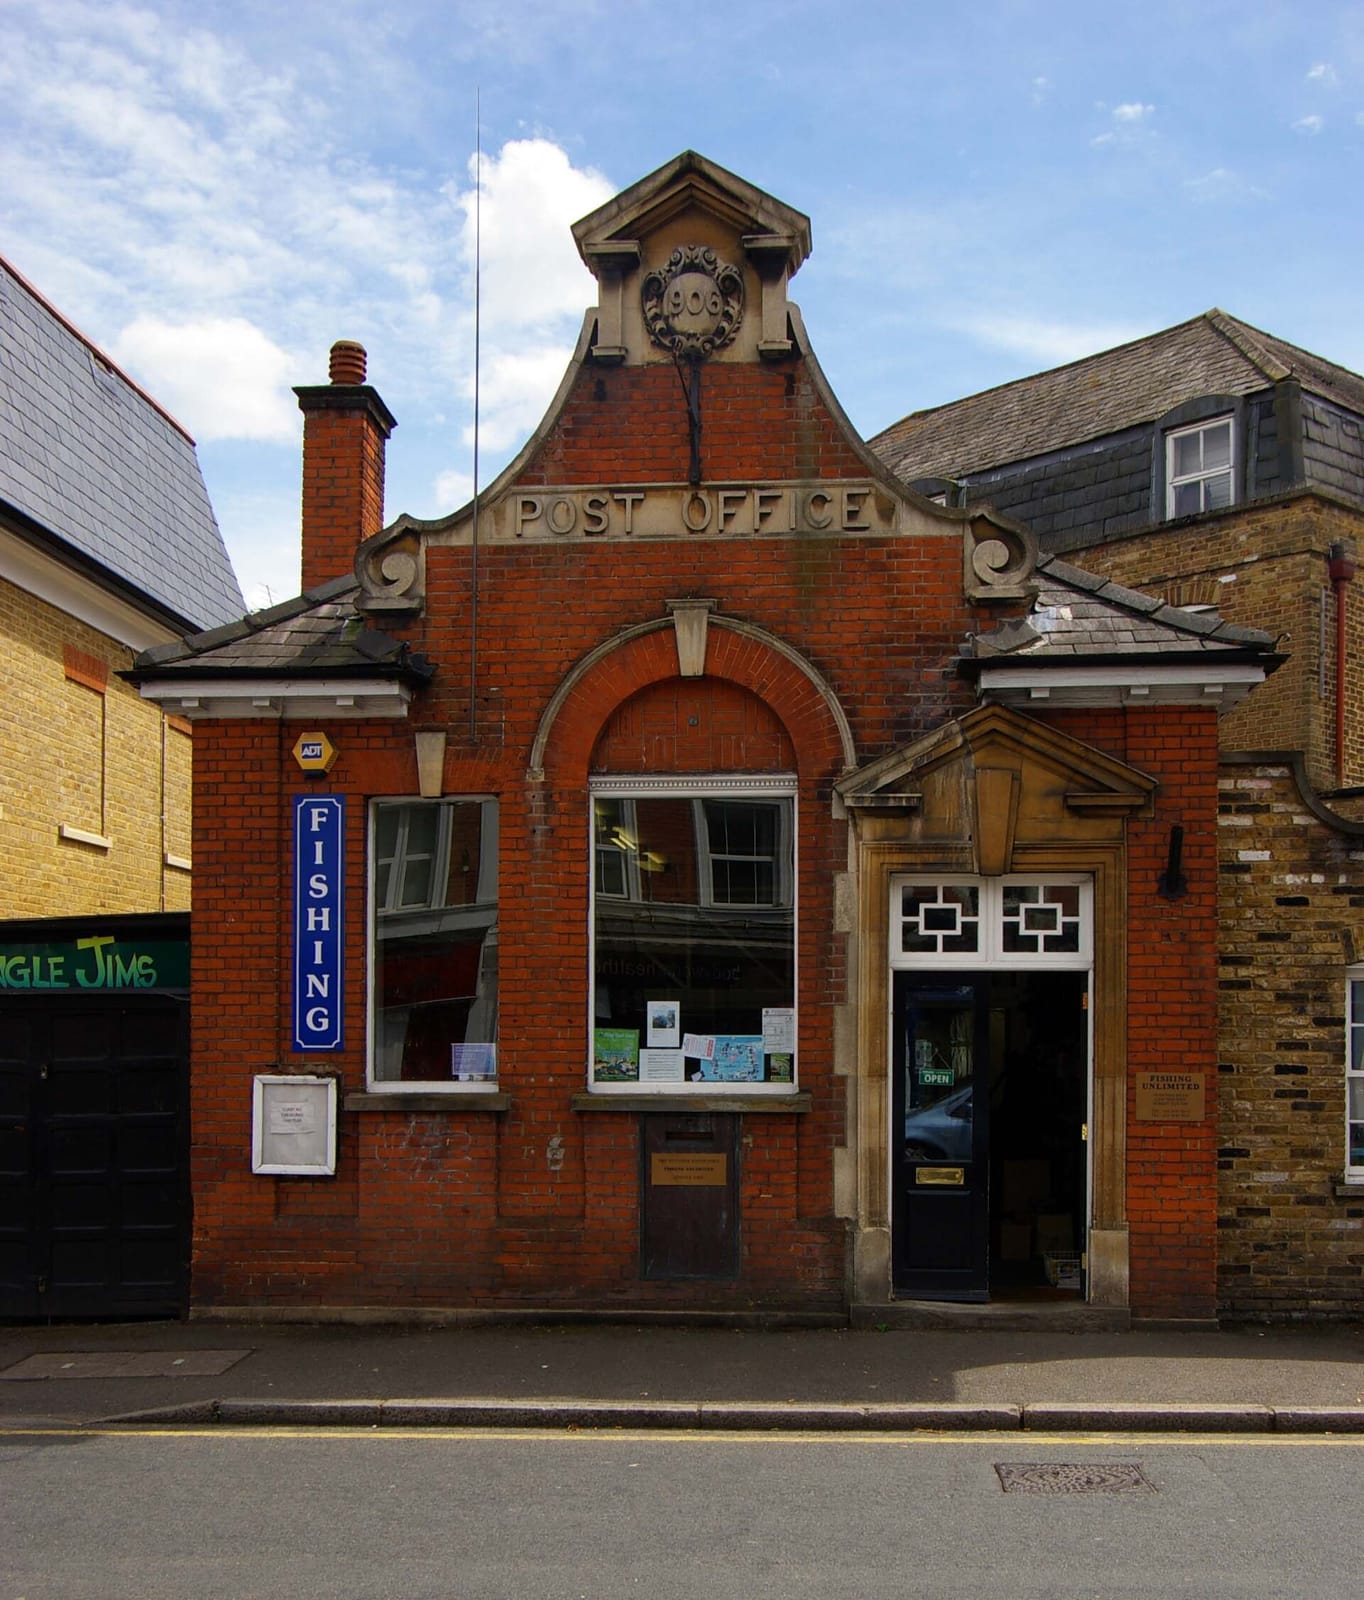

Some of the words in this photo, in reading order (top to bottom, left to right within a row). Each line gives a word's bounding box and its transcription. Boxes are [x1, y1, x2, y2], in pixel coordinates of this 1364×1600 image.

[515, 492, 645, 537] POST
[682, 487, 872, 533] OFFICE
[301, 745, 323, 757] ADT
[306, 807, 331, 1033] FISHING
[75, 935, 158, 989] JIMS
[924, 1073, 950, 1084] OPEN
